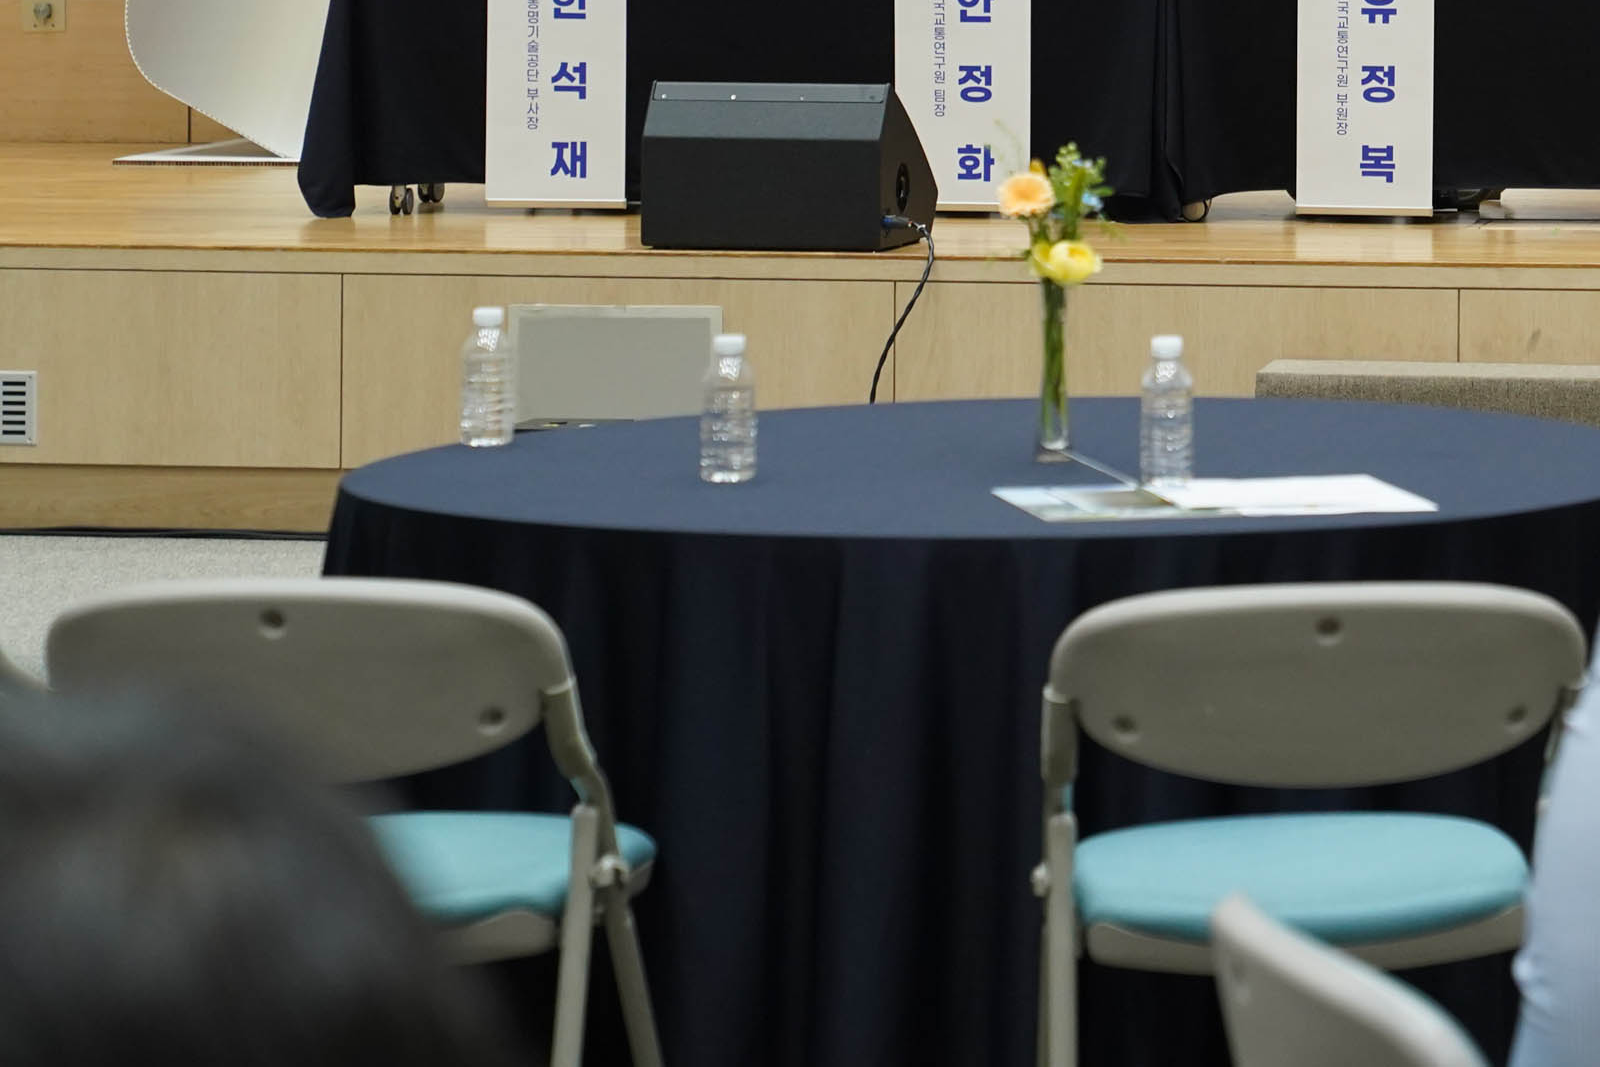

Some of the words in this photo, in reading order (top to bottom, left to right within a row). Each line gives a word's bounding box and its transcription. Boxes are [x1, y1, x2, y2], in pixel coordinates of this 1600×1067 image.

[527, 88, 539, 129] 부사장
[935, 90, 946, 117] 팀장
[1337, 94, 1348, 135] 부원장
